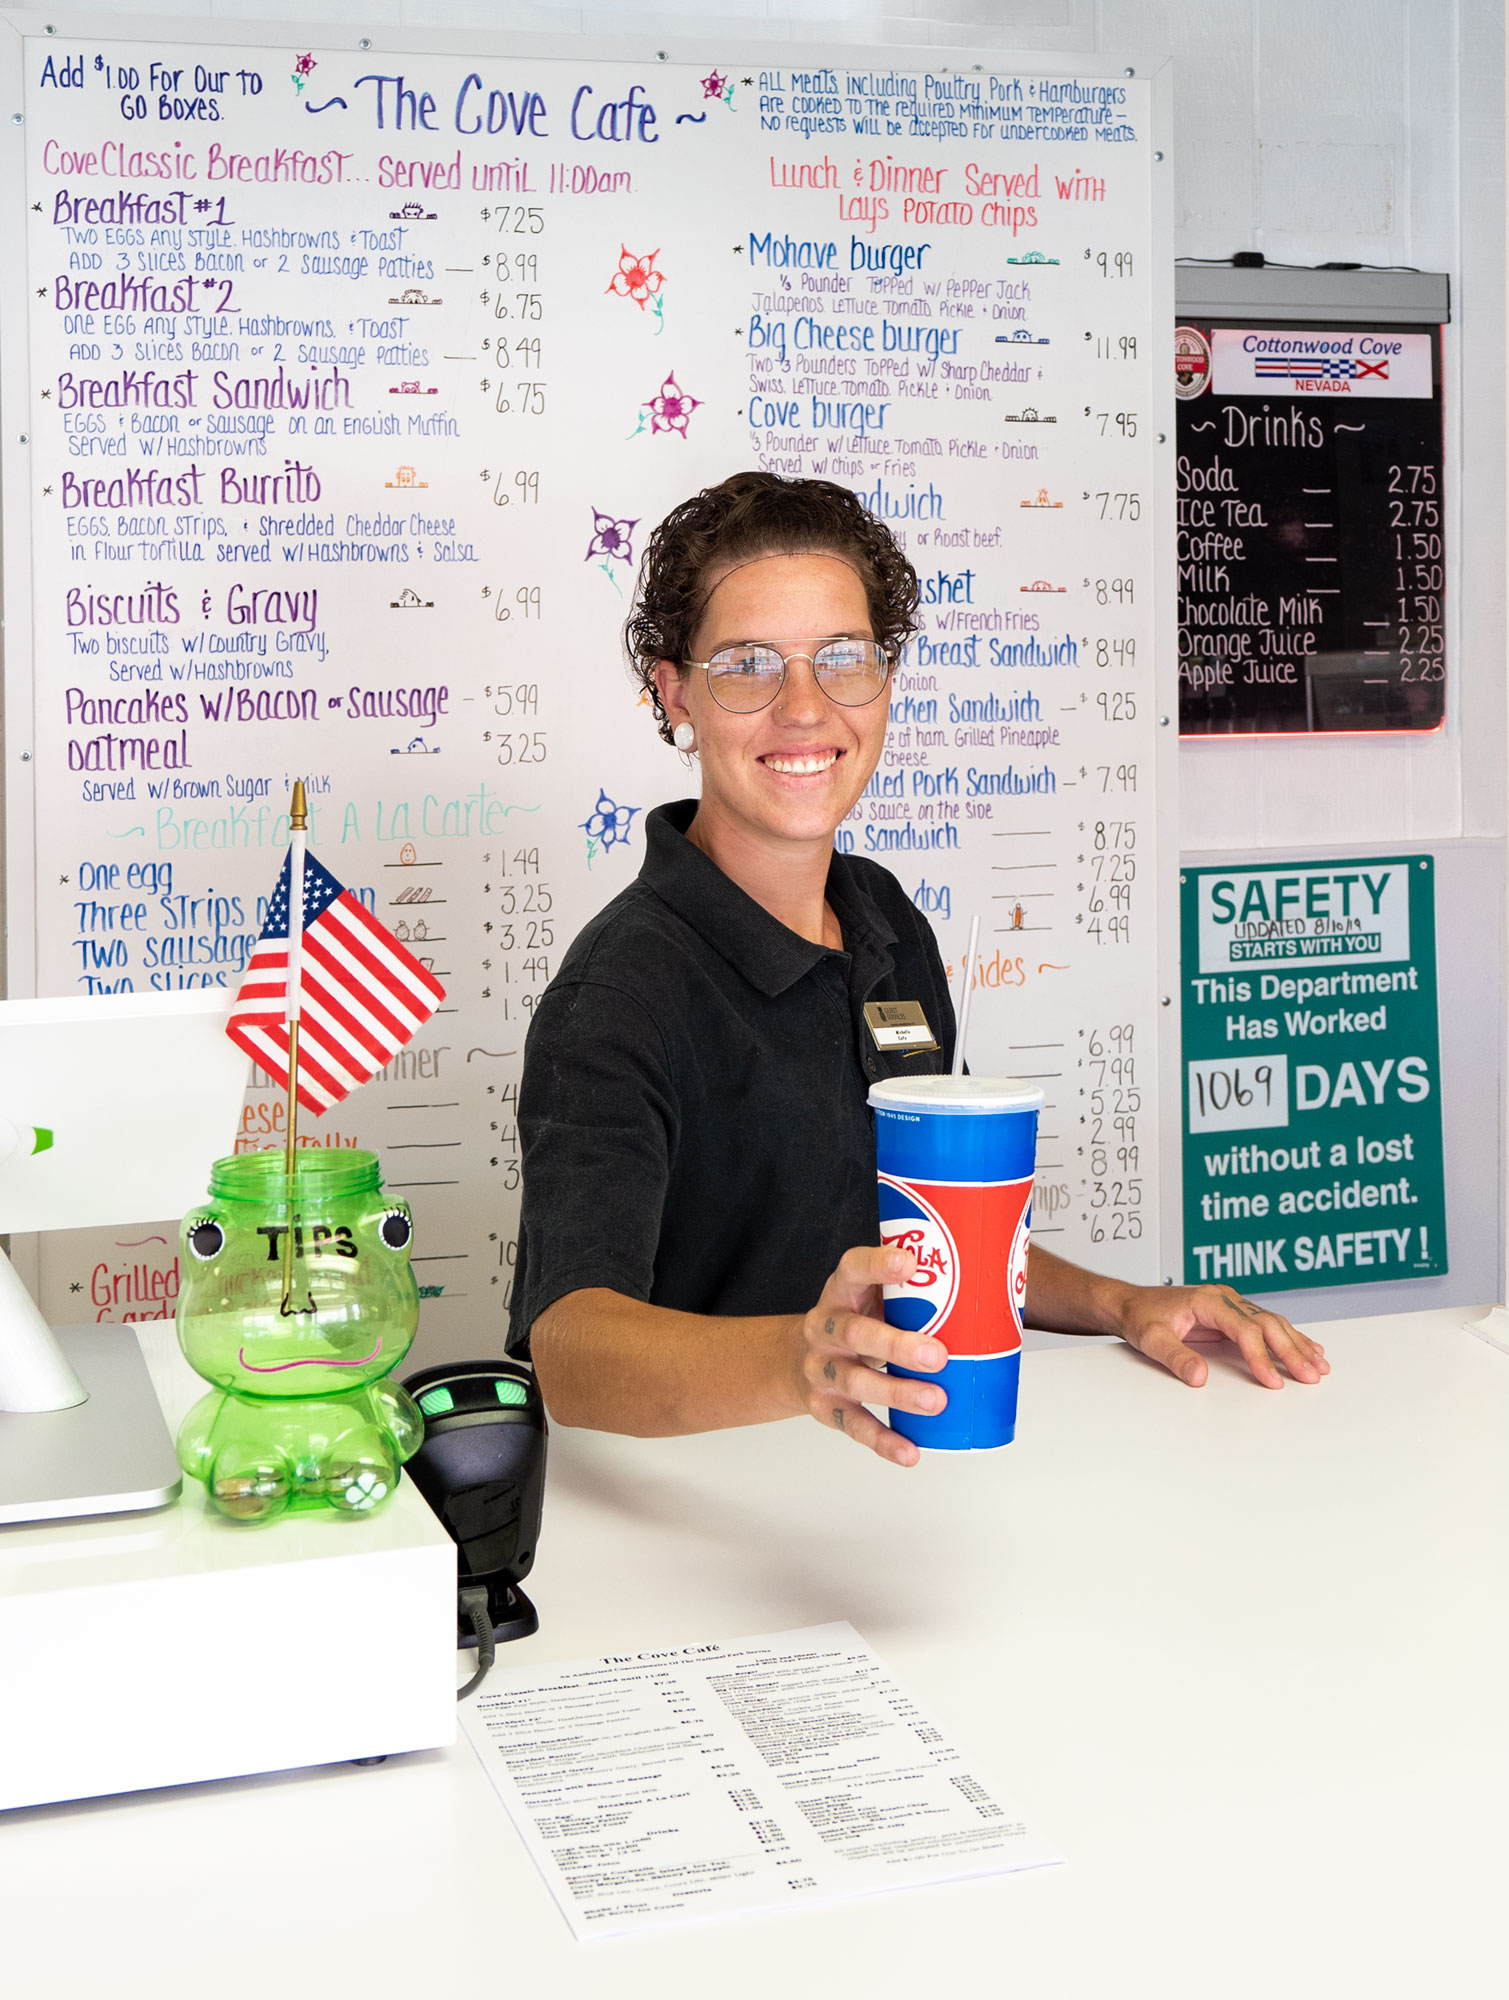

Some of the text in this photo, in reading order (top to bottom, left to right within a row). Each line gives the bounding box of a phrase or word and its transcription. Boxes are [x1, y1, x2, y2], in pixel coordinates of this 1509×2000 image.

[41, 55, 83, 88] Add
[94, 55, 139, 90] $1.00
[150, 63, 184, 91] For
[195, 65, 230, 92] Our
[354, 74, 658, 142] The Cove Cafe
[771, 156, 840, 188] Lunch
[869, 156, 948, 193] Dinner
[965, 163, 1041, 198] Served
[54, 190, 193, 225] Breakfast
[481, 206, 544, 234] $7.25
[482, 253, 537, 281] $8.99
[750, 233, 931, 278] Mohave burger
[1084, 249, 1132, 278] $9.99
[56, 273, 241, 313] Breakfast #2
[480, 292, 542, 320] $6.75
[481, 337, 540, 368] $8.49
[747, 313, 962, 362] Big Cheese burger
[1085, 332, 1136, 359] $11.99
[1243, 336, 1402, 355] Cottonwood Cove
[58, 366, 355, 410] Breakfast Sandwich
[480, 378, 546, 414] $6.75
[1294, 378, 1352, 394] NEVADA
[749, 395, 891, 438] Cove burger
[1085, 407, 1137, 437] $7.95
[1222, 405, 1323, 448] Drinks
[62, 460, 320, 508] Breakfast Burrito
[480, 470, 539, 506] $6.99
[1176, 455, 1239, 492] Soda
[1389, 466, 1435, 494] 2.75
[1083, 492, 1140, 521] $7.75
[1221, 500, 1268, 527] Tea
[1389, 501, 1438, 527] 2.75
[259, 513, 334, 536] Shredded
[410, 513, 456, 536] Cheese
[1176, 529, 1246, 562] Coffee
[1397, 533, 1441, 560] 1.50
[1084, 578, 1133, 605] $8.99
[1178, 563, 1229, 592] Milk
[1397, 565, 1443, 590] 1.50
[67, 581, 319, 635] Biscuits & Gravy
[482, 586, 540, 621] $6.99
[1178, 592, 1324, 626] Chocolate Milk
[1399, 596, 1440, 622] 1.50
[1005, 612, 1039, 631] Fries
[66, 632, 99, 654] Two
[918, 634, 1077, 667] Breast Sandwich
[1082, 638, 1135, 667] $8.49
[1178, 625, 1318, 663] Orange Juice
[1399, 625, 1444, 655] 2.25
[1178, 657, 1297, 692] Apple Juice
[1400, 658, 1444, 682] 2.25
[66, 688, 188, 724] Pancakes
[347, 686, 448, 727] Sausage
[485, 684, 537, 715] $5.99
[949, 690, 1043, 723] Sandwich
[1080, 692, 1136, 720] $9.25
[483, 731, 546, 765] $3.25
[913, 766, 1055, 796] Pork Sandwich
[1080, 765, 1136, 792] $7.99
[865, 821, 957, 851] Sandwich
[1078, 821, 1135, 850] $8.75
[483, 848, 539, 877] $1.49
[1078, 854, 1135, 882] $7.25
[80, 862, 172, 896] One egg
[484, 883, 552, 914] $3.25
[1077, 883, 1130, 912] $6.99
[1211, 872, 1390, 925] SAFETY
[74, 901, 146, 932] Three
[1076, 914, 1129, 944] $4.99
[483, 919, 553, 950] $3.25
[1231, 933, 1380, 960] STARTS WITH YOU
[482, 956, 551, 983] $1.49
[1191, 966, 1418, 1004] This Department
[1226, 1006, 1386, 1041] Has Worked
[1079, 1024, 1134, 1056] $6.99
[1078, 1058, 1134, 1086] $7.99
[1296, 1057, 1429, 1110] DAYS
[1080, 1088, 1140, 1116] $5.25
[1195, 1064, 1274, 1118] 1069
[897, 1113, 921, 1122] DESIGN
[1080, 1116, 1135, 1144] $2.99
[1077, 1146, 1138, 1176] $8.99
[1205, 1133, 1415, 1176] without a lost
[1082, 1179, 1142, 1208] $3.25
[1200, 1178, 1417, 1221] time accident.
[1082, 1211, 1142, 1243] $6.25
[1192, 1238, 1288, 1280] THINK
[1294, 1227, 1412, 1270] SAFETY
[602, 1655, 633, 1665] The
[637, 1650, 679, 1661] Cove
